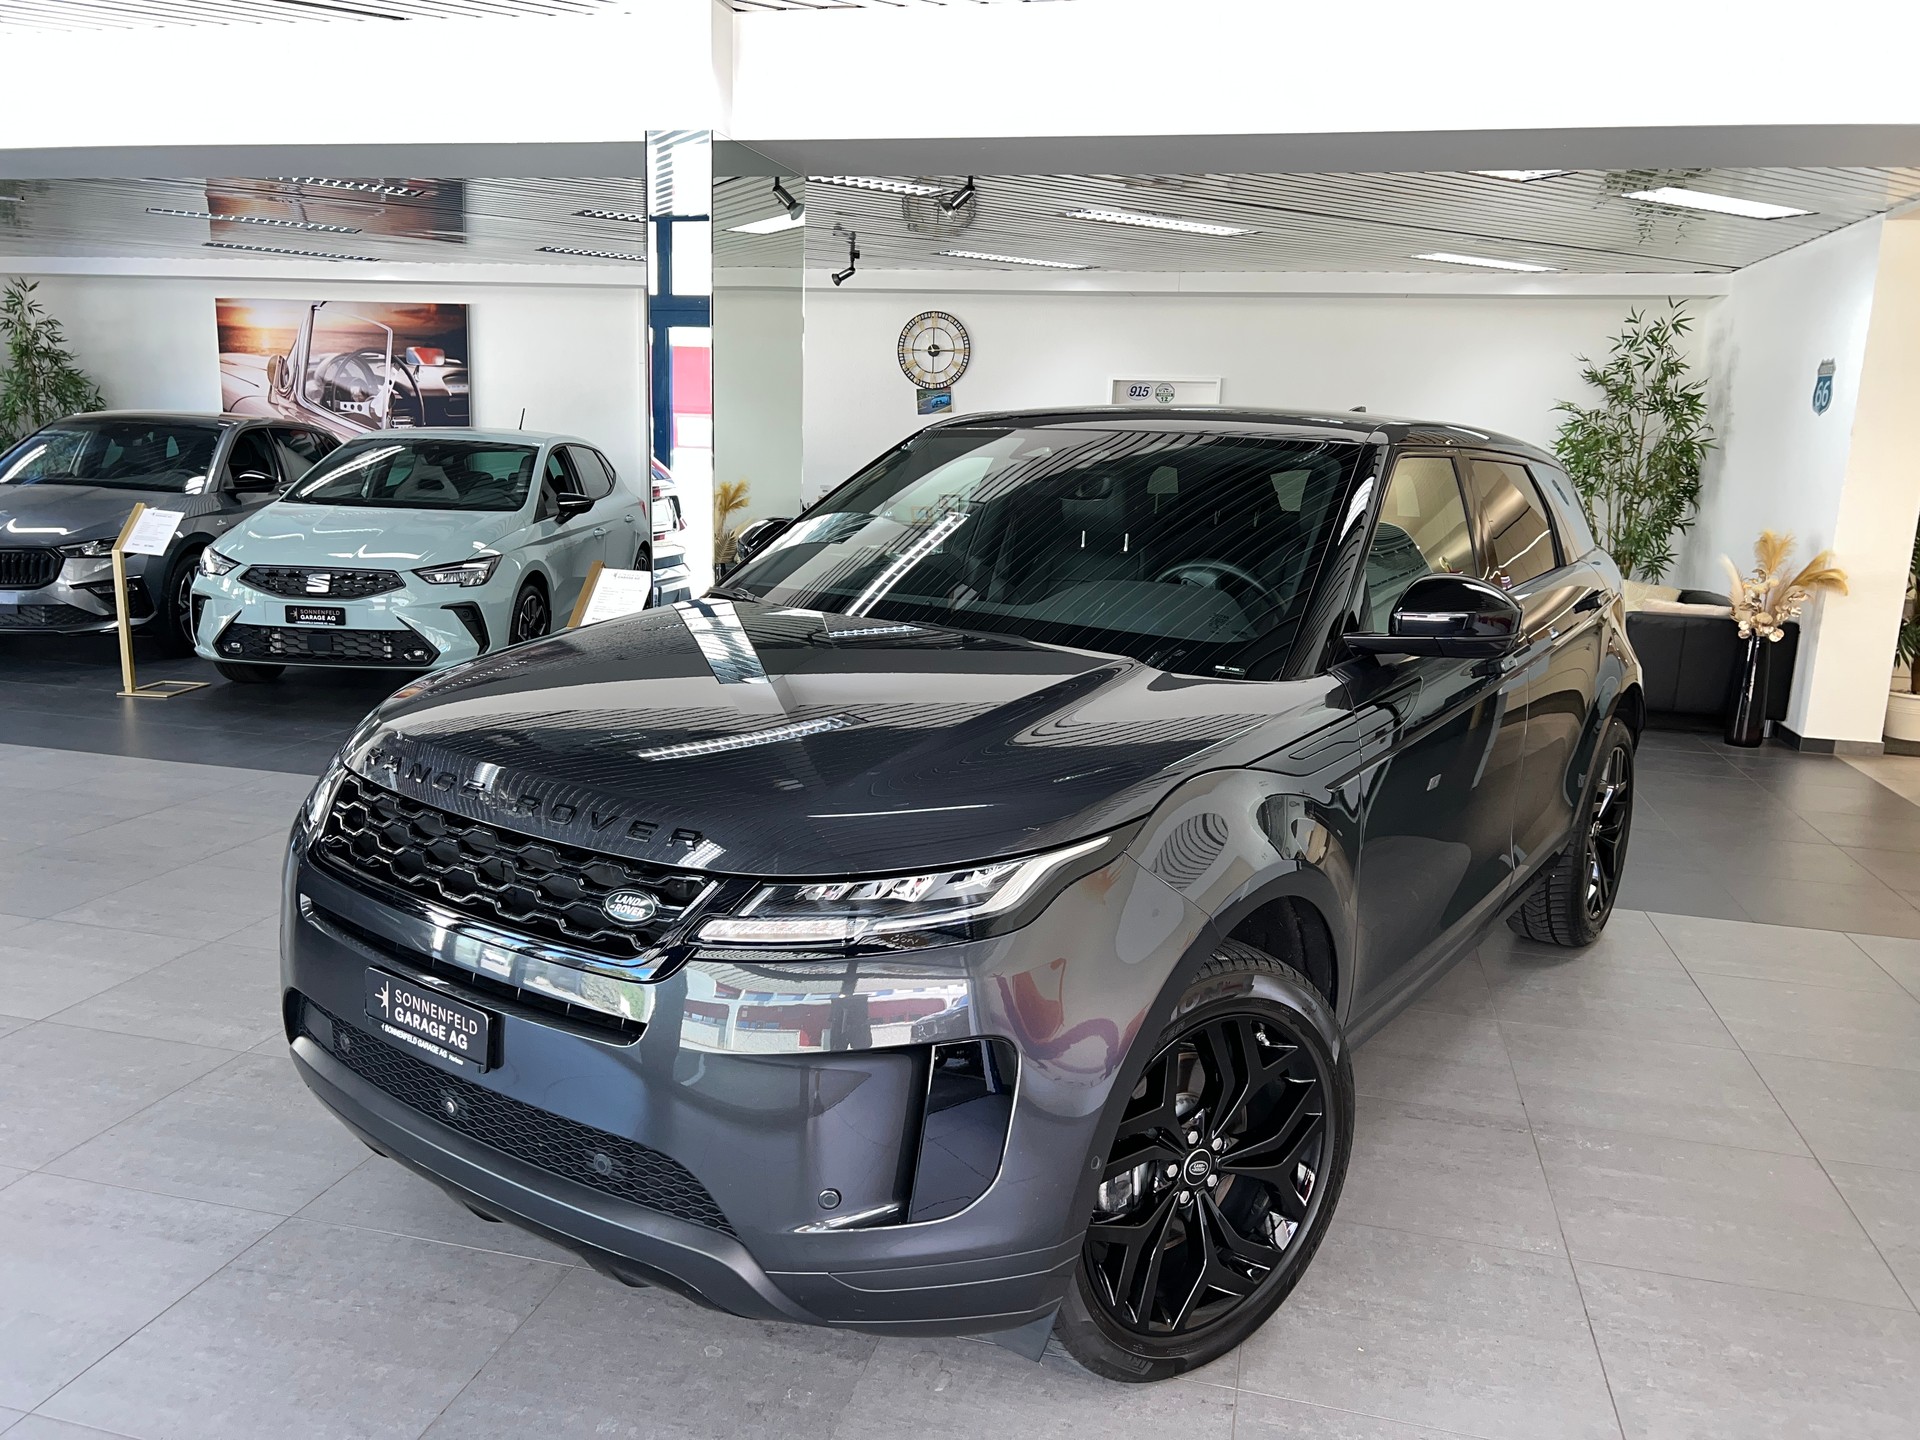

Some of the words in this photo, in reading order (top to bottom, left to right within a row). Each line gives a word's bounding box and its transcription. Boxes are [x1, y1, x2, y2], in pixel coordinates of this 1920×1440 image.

[1129, 385, 1150, 397] 915
[1815, 381, 1831, 407] 66
[366, 747, 487, 801] RANGE
[512, 794, 705, 851] ROVER
[613, 903, 646, 918] ROVER
[614, 894, 642, 906] LAND
[394, 989, 478, 1035] SONNENFELD
[384, 1024, 418, 1045] SONNENFELD
[417, 1039, 440, 1055] GARAGE
[439, 1047, 448, 1059] AG
[394, 1007, 446, 1041] GARAGE
[449, 1029, 468, 1051] AG
